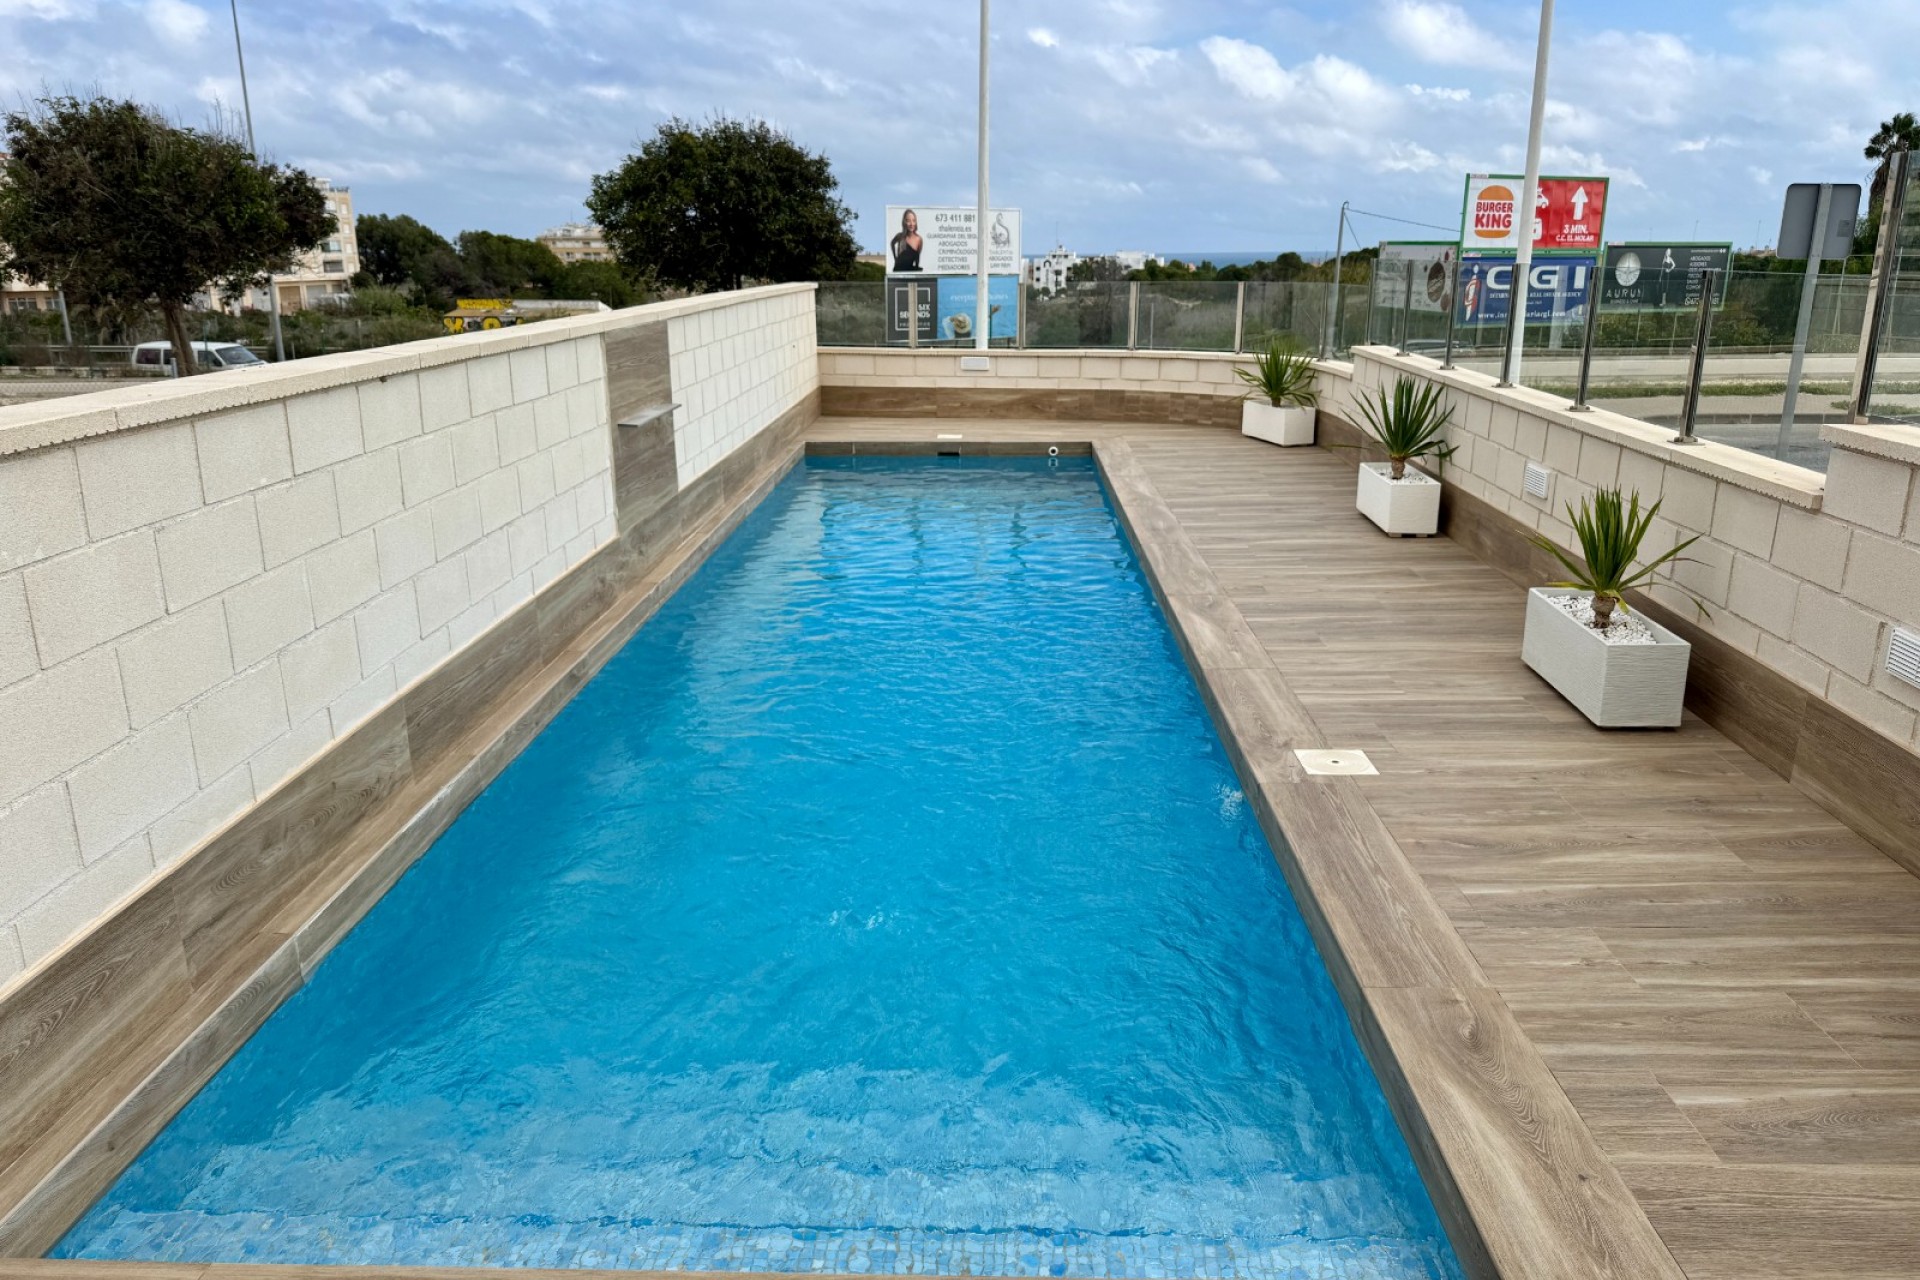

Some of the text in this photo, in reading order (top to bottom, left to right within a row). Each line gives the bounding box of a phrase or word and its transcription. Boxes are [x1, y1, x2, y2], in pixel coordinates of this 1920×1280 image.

[1475, 202, 1513, 213] BURGER
[935, 213, 948, 222] 673
[950, 214, 962, 222] 411
[1474, 213, 1513, 228] KING
[1563, 224, 1588, 234] 3 MIN.
